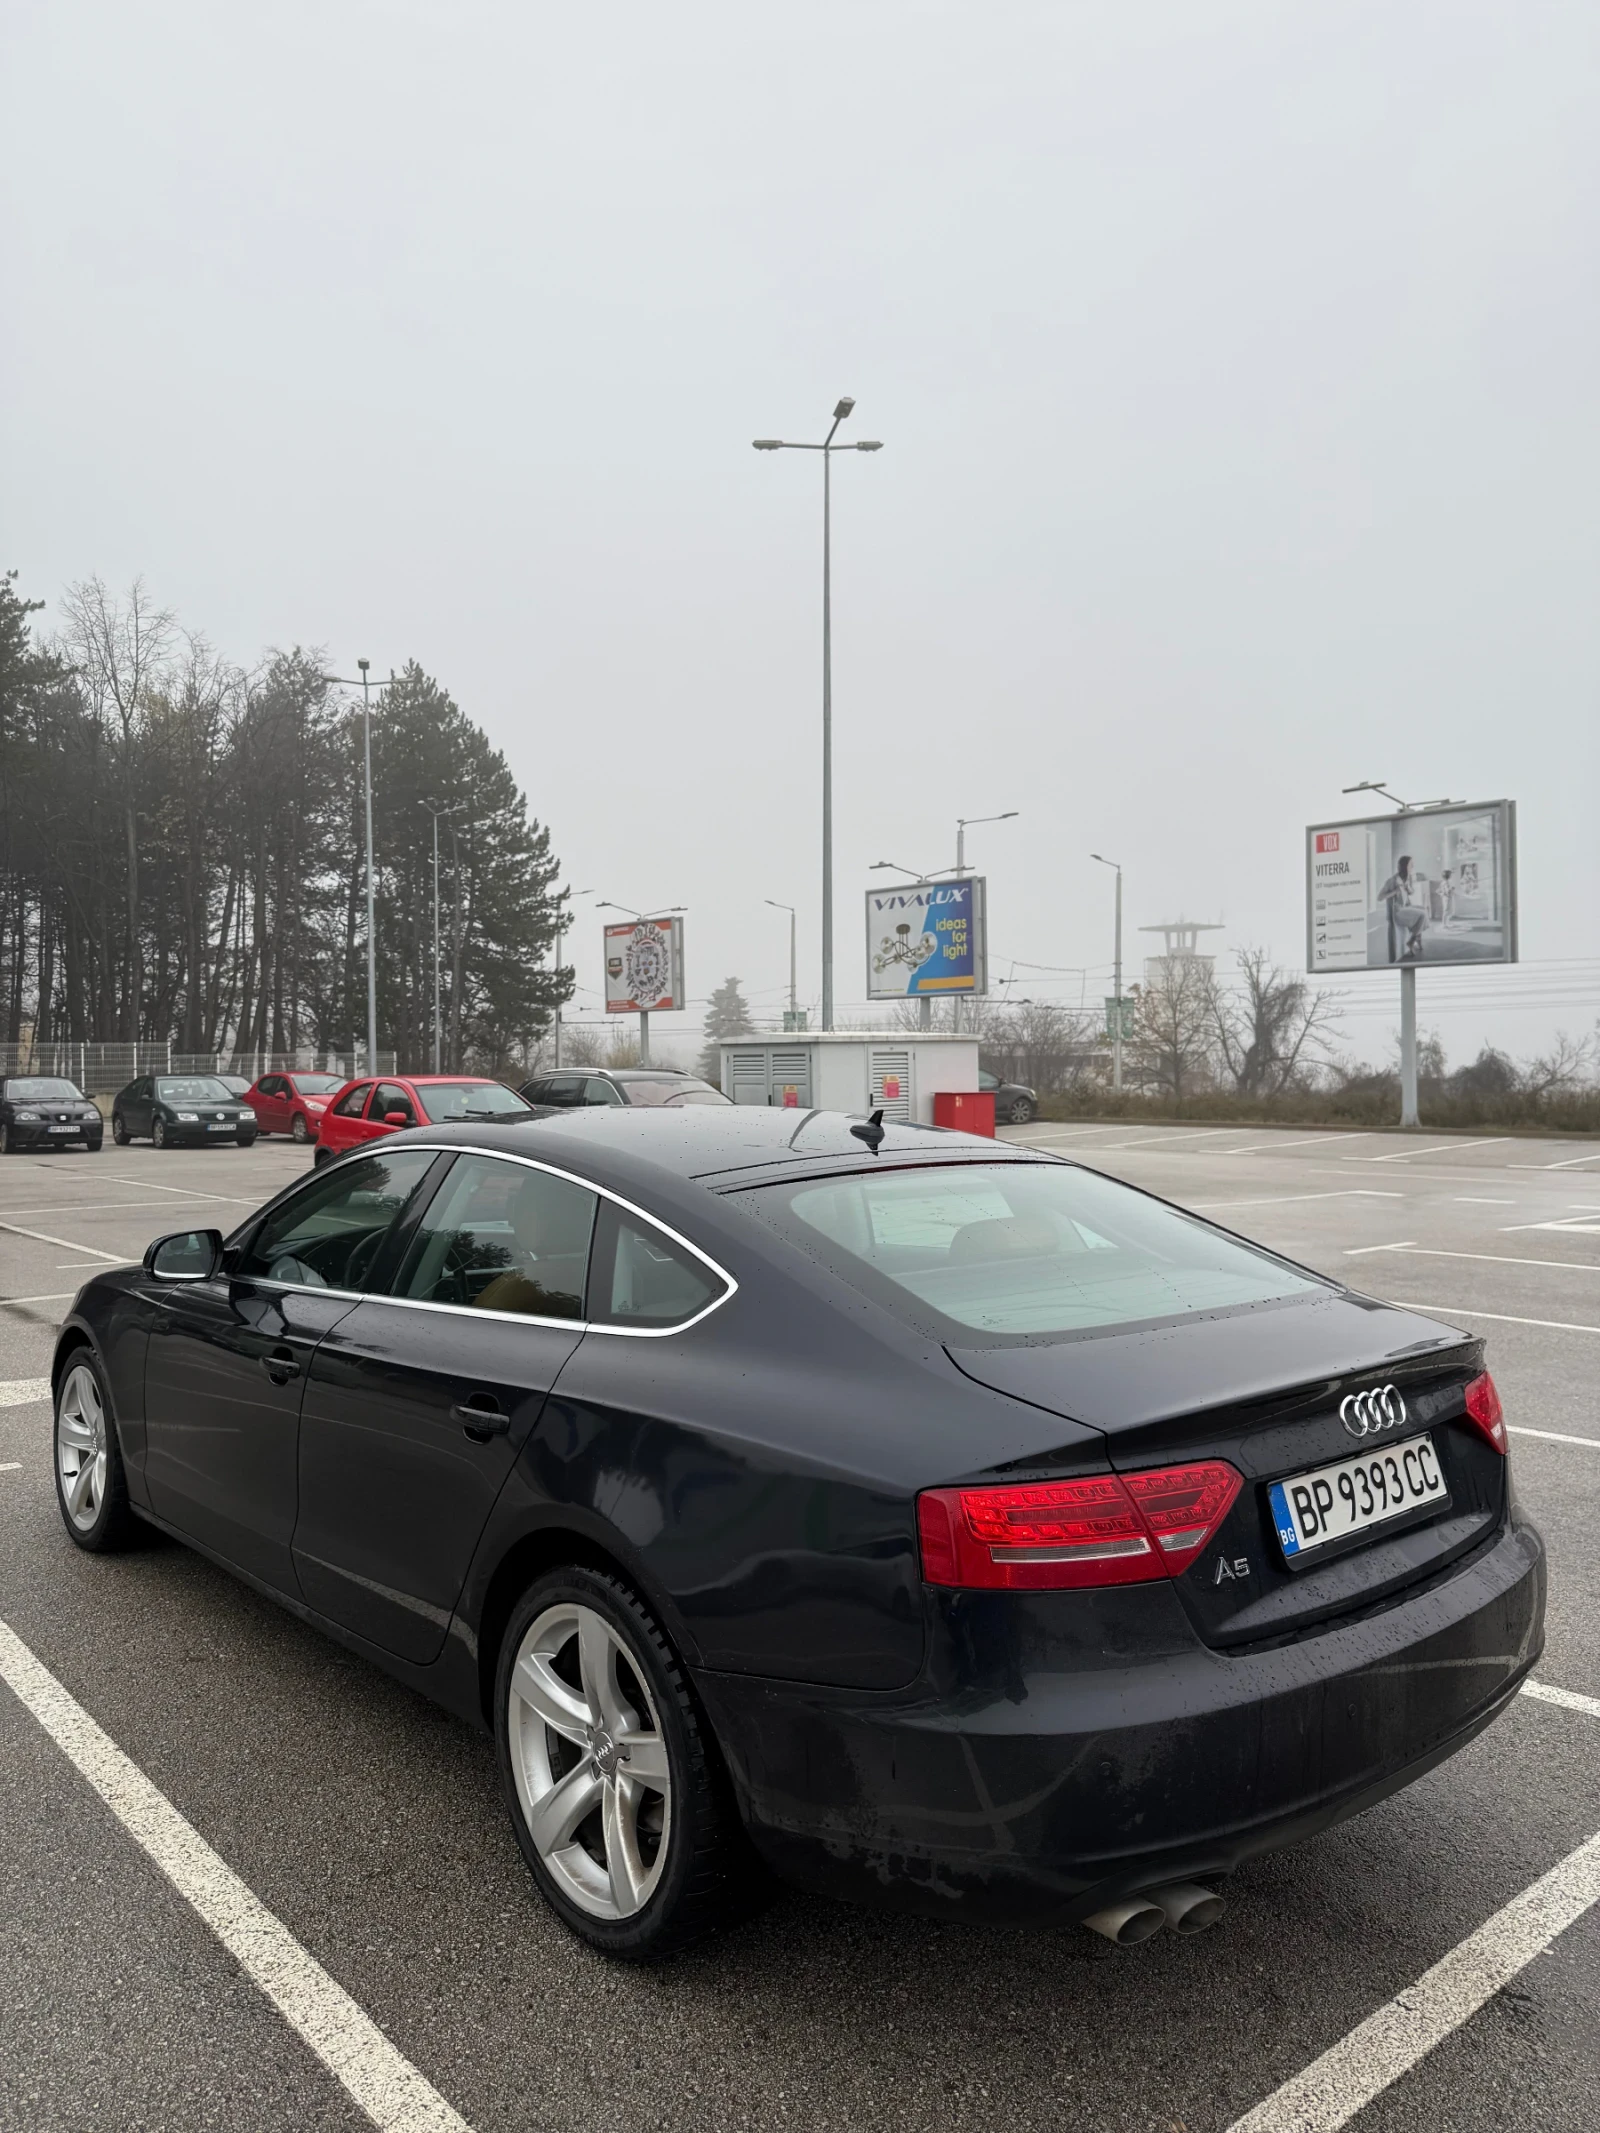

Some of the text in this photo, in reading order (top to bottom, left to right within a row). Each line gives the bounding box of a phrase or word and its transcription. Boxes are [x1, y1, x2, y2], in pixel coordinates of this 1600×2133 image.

[1323, 833, 1338, 851] VOX
[1315, 861, 1350, 877] VITERRA
[875, 888, 967, 911] VIVALUX
[936, 918, 967, 931] ideas
[952, 931, 967, 943] for
[943, 944, 967, 960] light
[1291, 1444, 1439, 1539] BP 9393 CC
[1279, 1527, 1295, 1545] BG
[1213, 1556, 1251, 1585] A5
